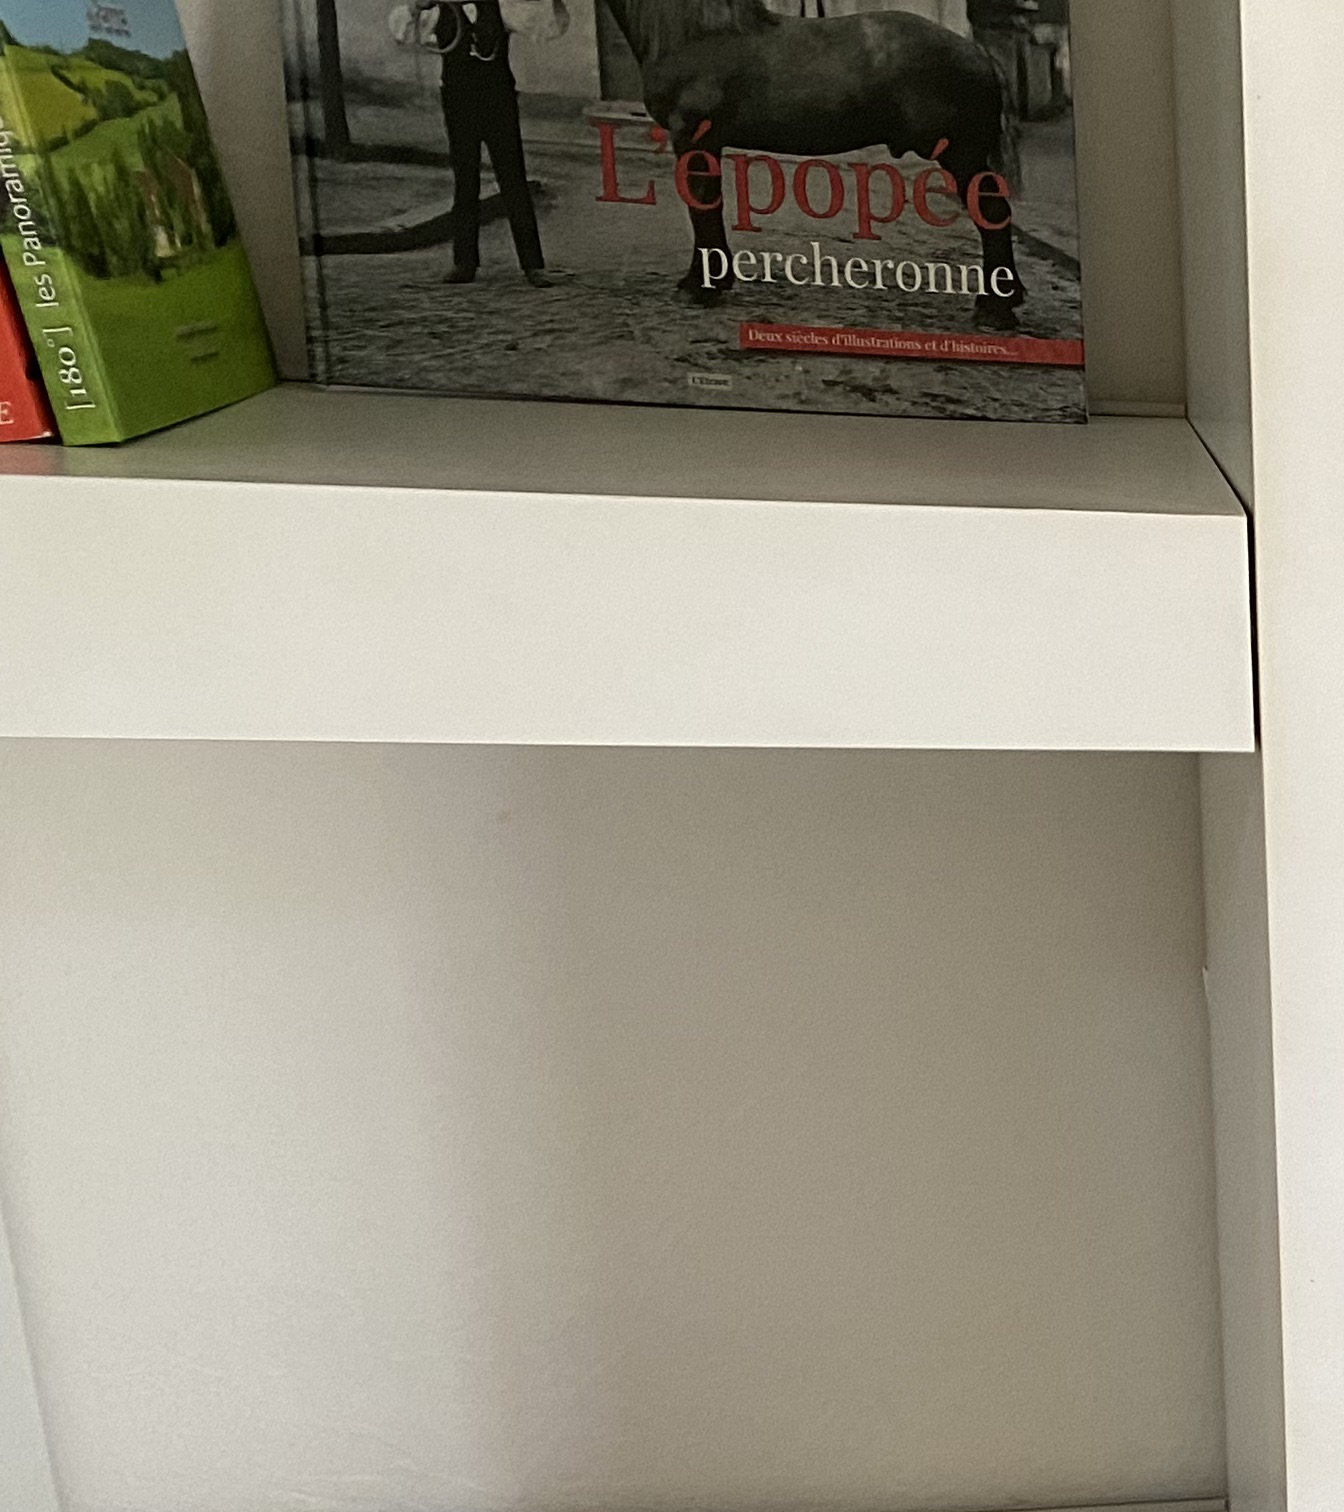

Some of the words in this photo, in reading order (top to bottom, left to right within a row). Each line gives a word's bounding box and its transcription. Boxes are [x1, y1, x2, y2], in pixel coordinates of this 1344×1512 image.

[592, 119, 1012, 240] L'épopée
[36, 274, 57, 308] les
[697, 241, 1016, 298] percheronne
[748, 328, 783, 344] Deux
[785, 331, 829, 346] siècles
[832, 333, 922, 351] d'illustrations
[924, 338, 937, 351] et
